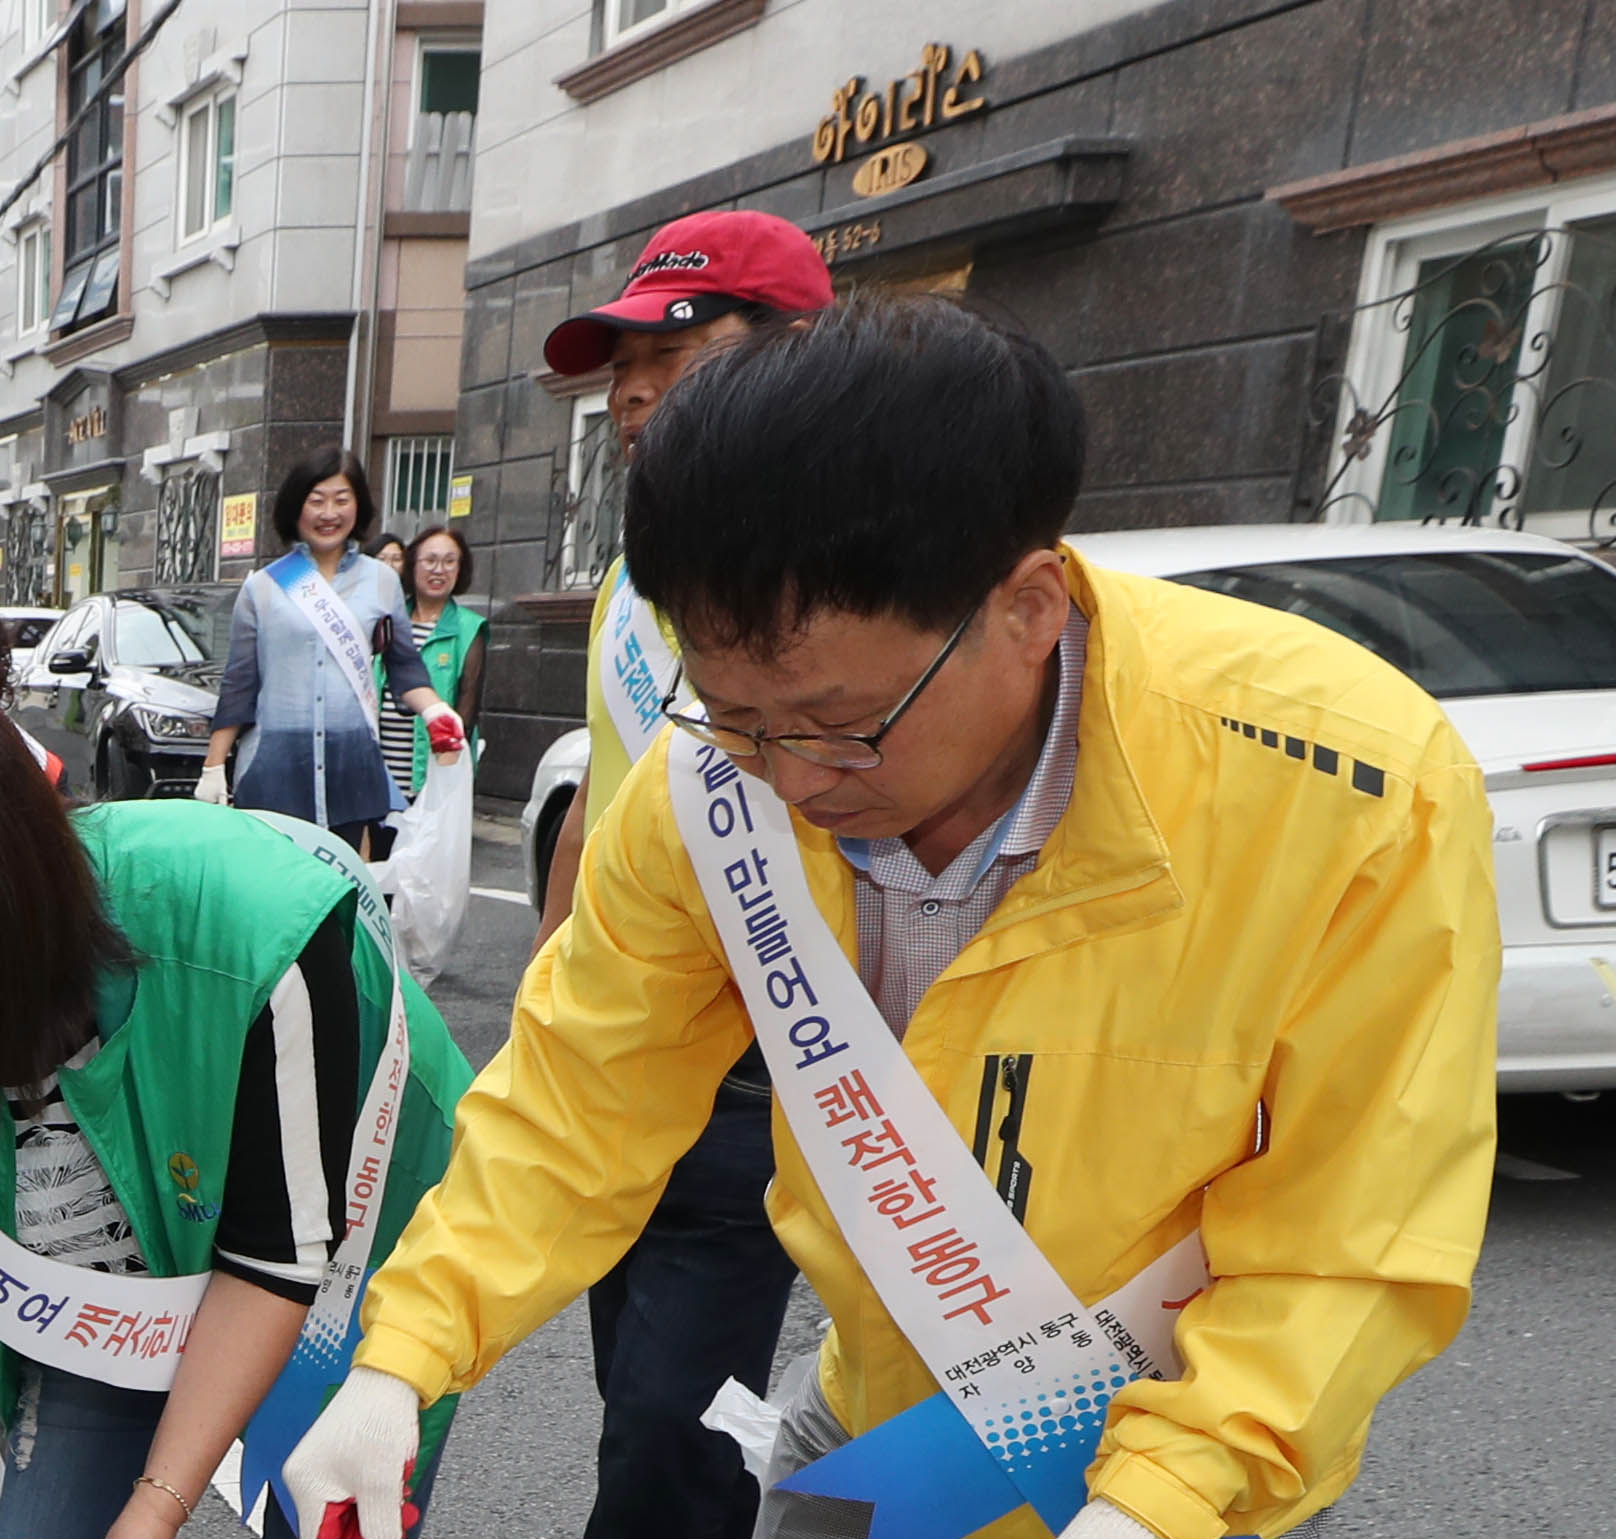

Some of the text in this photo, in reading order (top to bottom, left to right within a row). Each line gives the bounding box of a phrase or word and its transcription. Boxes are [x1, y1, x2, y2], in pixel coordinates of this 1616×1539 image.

[812, 43, 985, 164] 아이리스
[867, 148, 915, 194] IRIS
[843, 219, 882, 252] 52-6
[724, 847, 849, 1071] 만들어요
[813, 1067, 948, 1231] 쾌적한
[906, 1224, 1013, 1326] 동구
[945, 1312, 1079, 1382] 대전광역시 동구
[1094, 1309, 1153, 1374] 대전광역시
